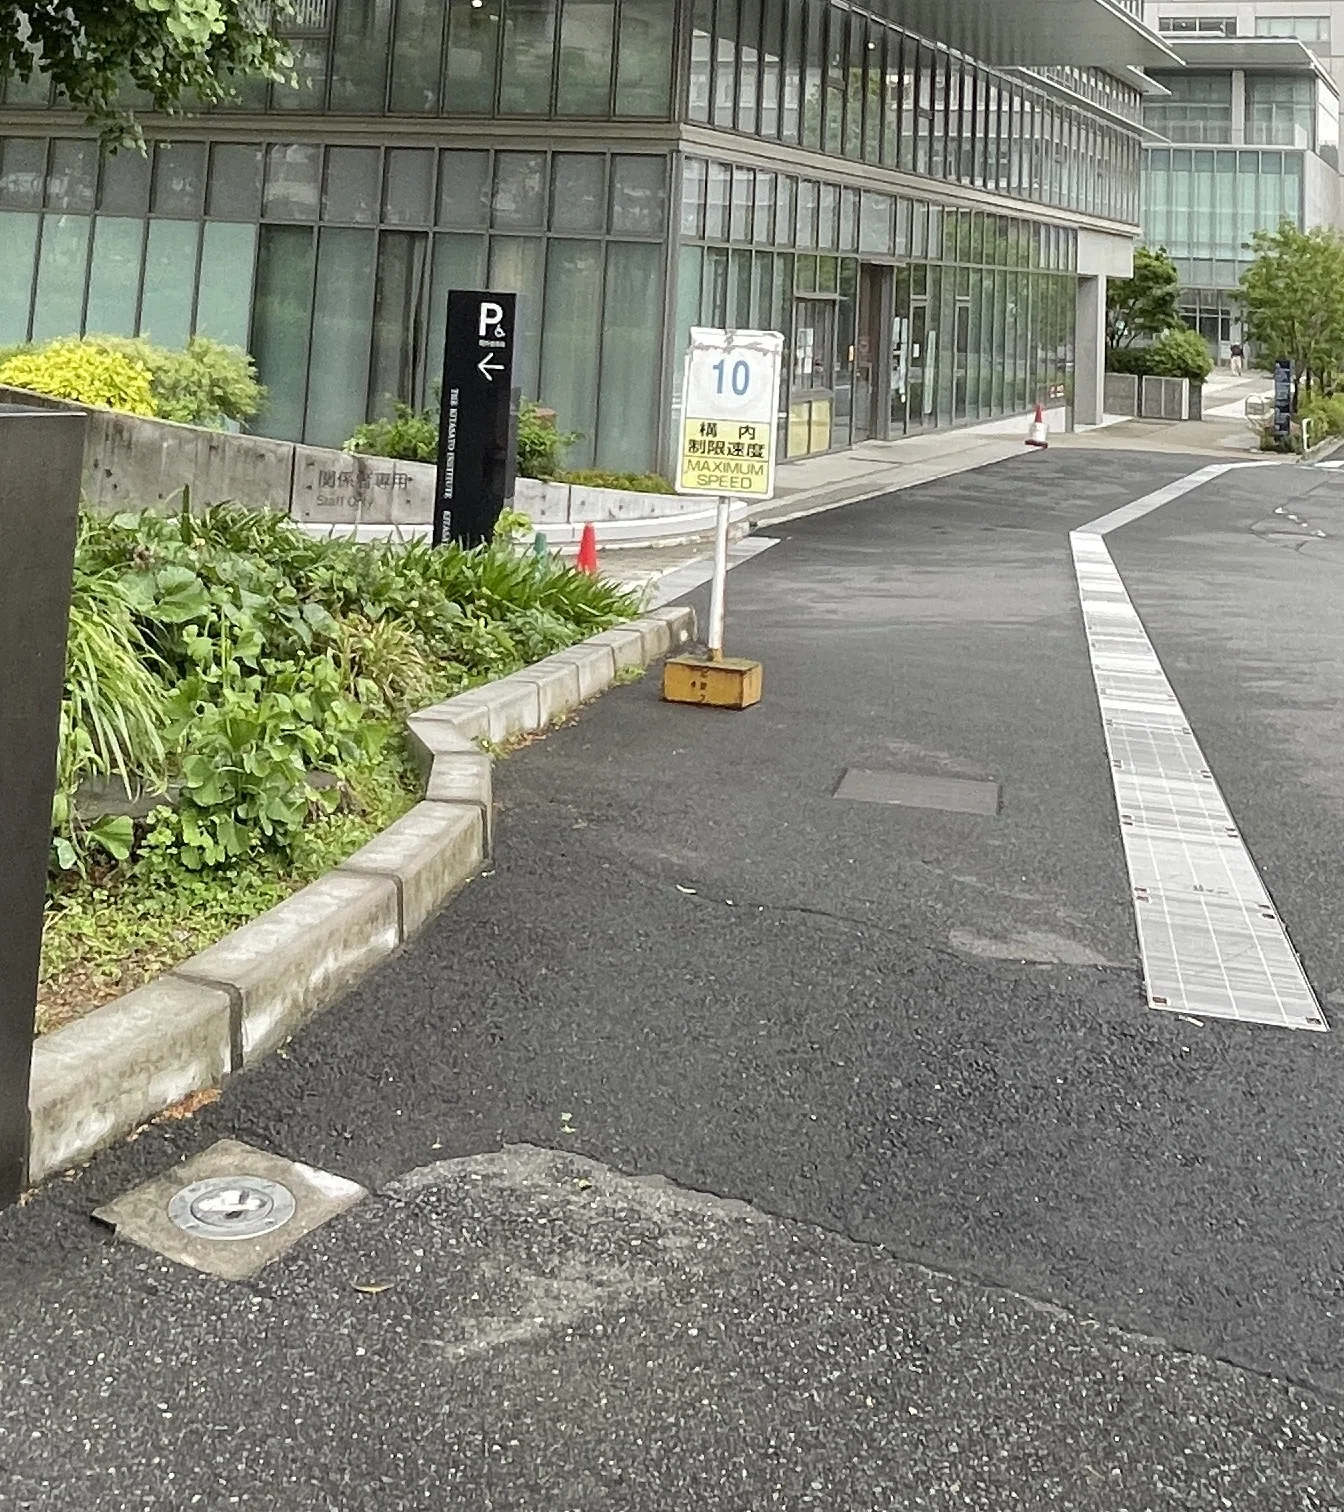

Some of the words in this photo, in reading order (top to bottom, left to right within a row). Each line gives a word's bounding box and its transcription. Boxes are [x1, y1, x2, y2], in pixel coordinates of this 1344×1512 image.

[479, 302, 504, 336] P
[712, 358, 751, 396] 10
[688, 439, 765, 459] 制限速度
[686, 459, 764, 476] MAXIMUM
[697, 474, 752, 489] SPEED
